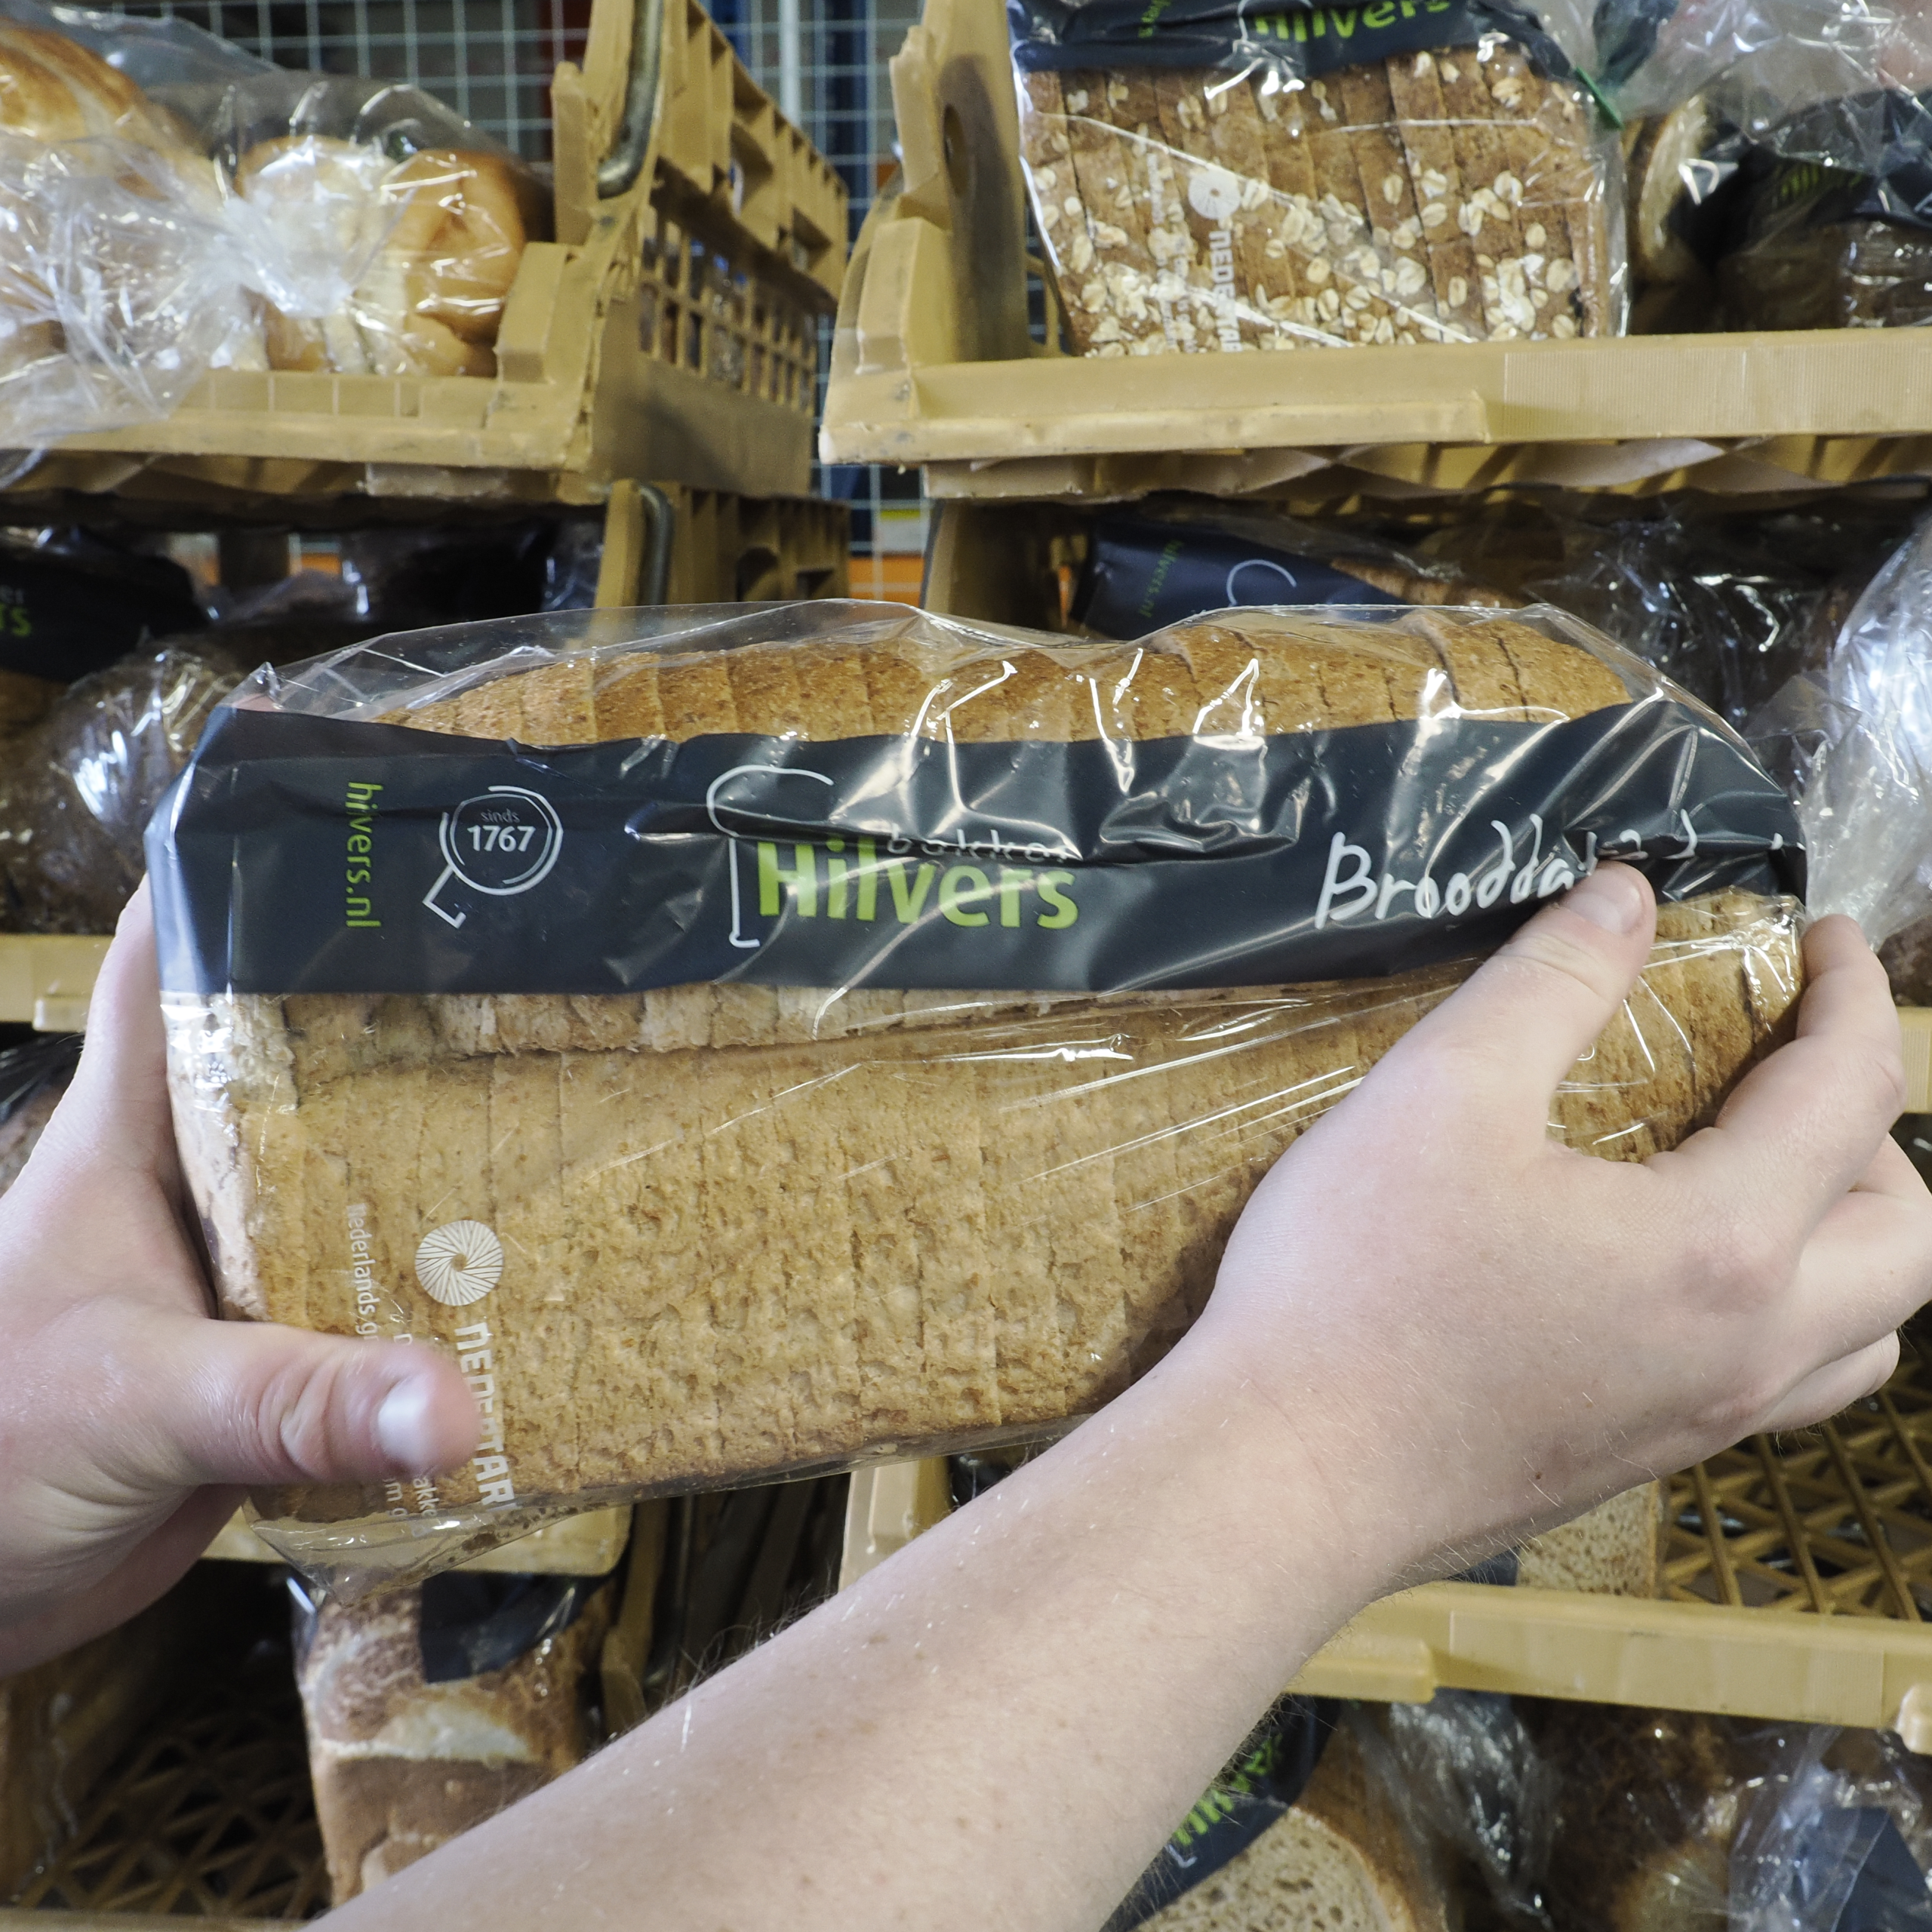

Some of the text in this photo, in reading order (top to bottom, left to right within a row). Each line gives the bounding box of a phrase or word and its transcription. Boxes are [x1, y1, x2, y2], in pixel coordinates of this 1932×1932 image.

[345, 782, 383, 928] hivers.nl
[467, 826, 537, 852] 1767
[481, 808, 519, 823] sinds
[757, 835, 1078, 929] Hilvers
[346, 1203, 380, 1315] nederlands
